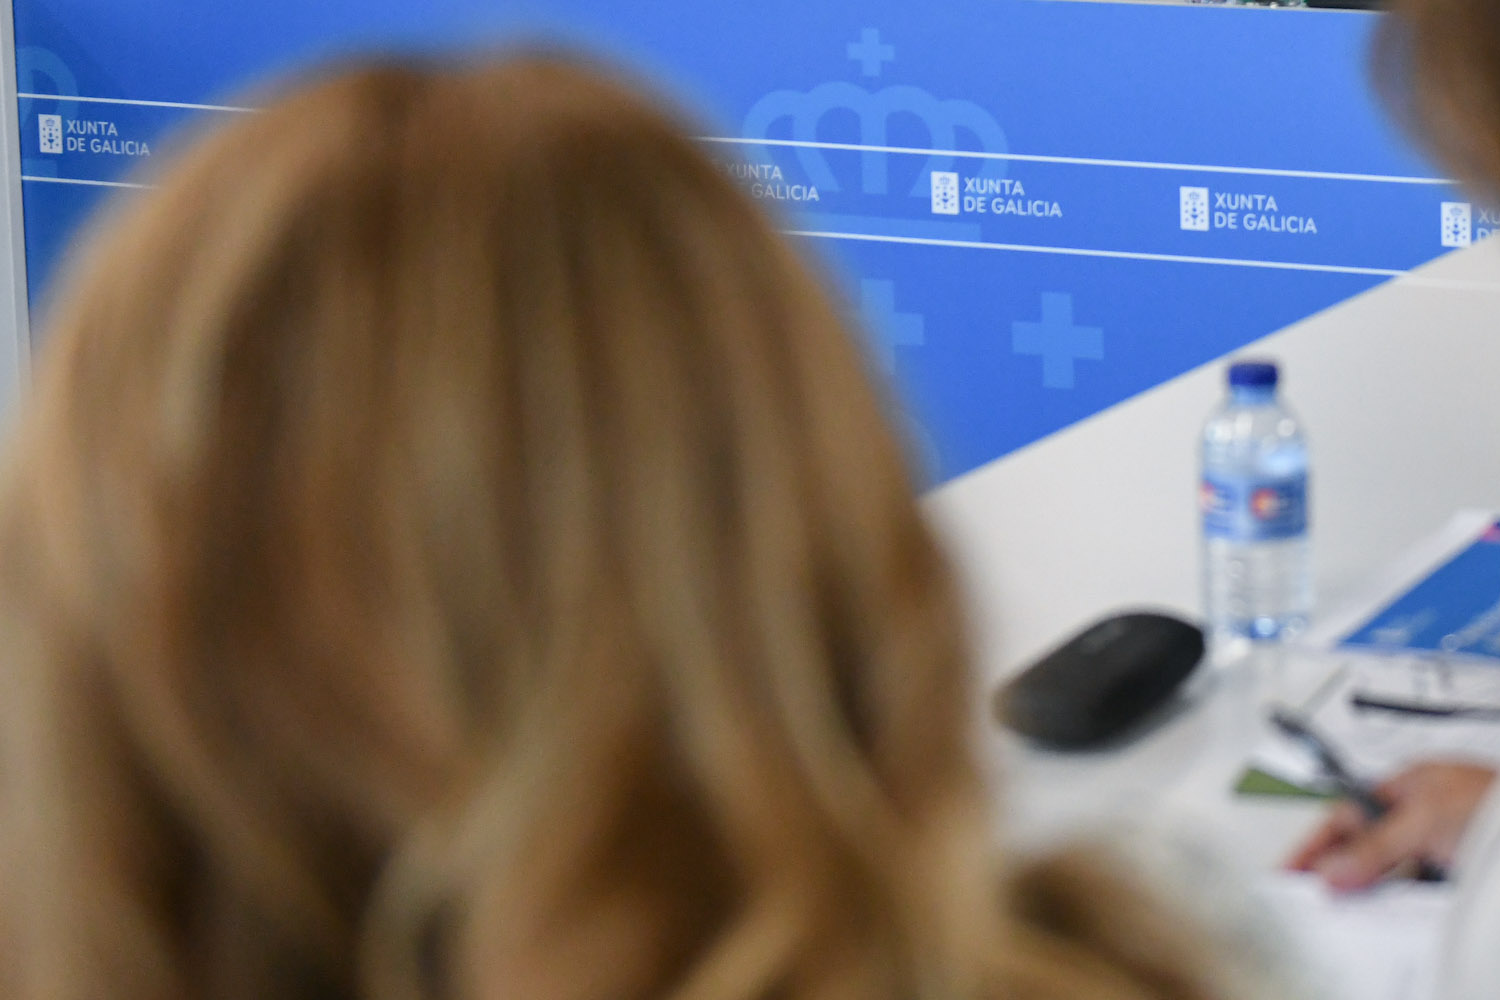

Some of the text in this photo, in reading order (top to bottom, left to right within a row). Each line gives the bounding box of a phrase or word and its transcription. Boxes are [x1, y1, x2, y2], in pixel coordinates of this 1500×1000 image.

[66, 119, 118, 136] XUNTA
[66, 137, 150, 156] DE GALICIA
[751, 183, 820, 201] GALICIA
[964, 177, 1025, 196] XUNTA
[963, 196, 1063, 218] DE GALICIA
[1214, 192, 1278, 212] XUNTA
[1214, 211, 1318, 234] DE GALICIA
